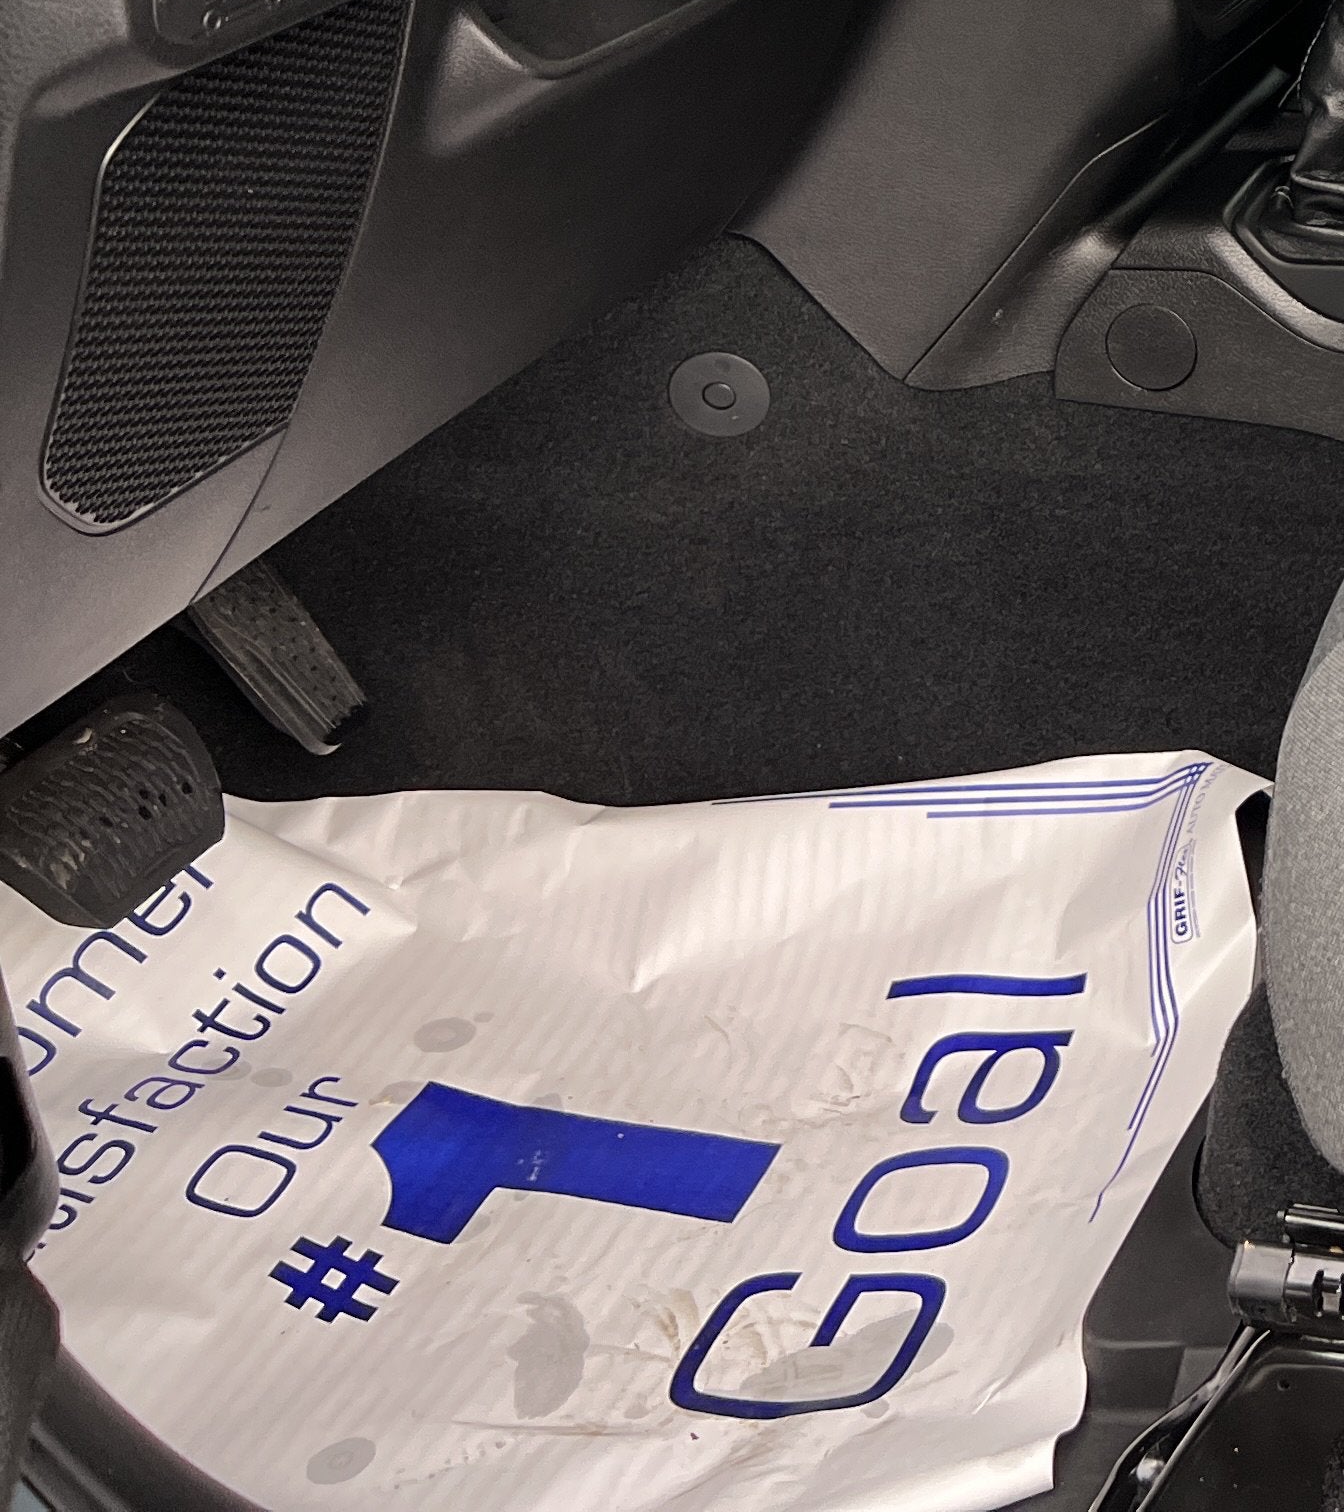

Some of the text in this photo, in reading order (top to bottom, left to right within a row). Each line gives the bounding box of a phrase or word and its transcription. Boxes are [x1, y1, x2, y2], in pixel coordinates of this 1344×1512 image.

[186, 1076, 358, 1218] Our
[268, 1081, 783, 1327] #1
[667, 971, 1088, 1421] Goal
